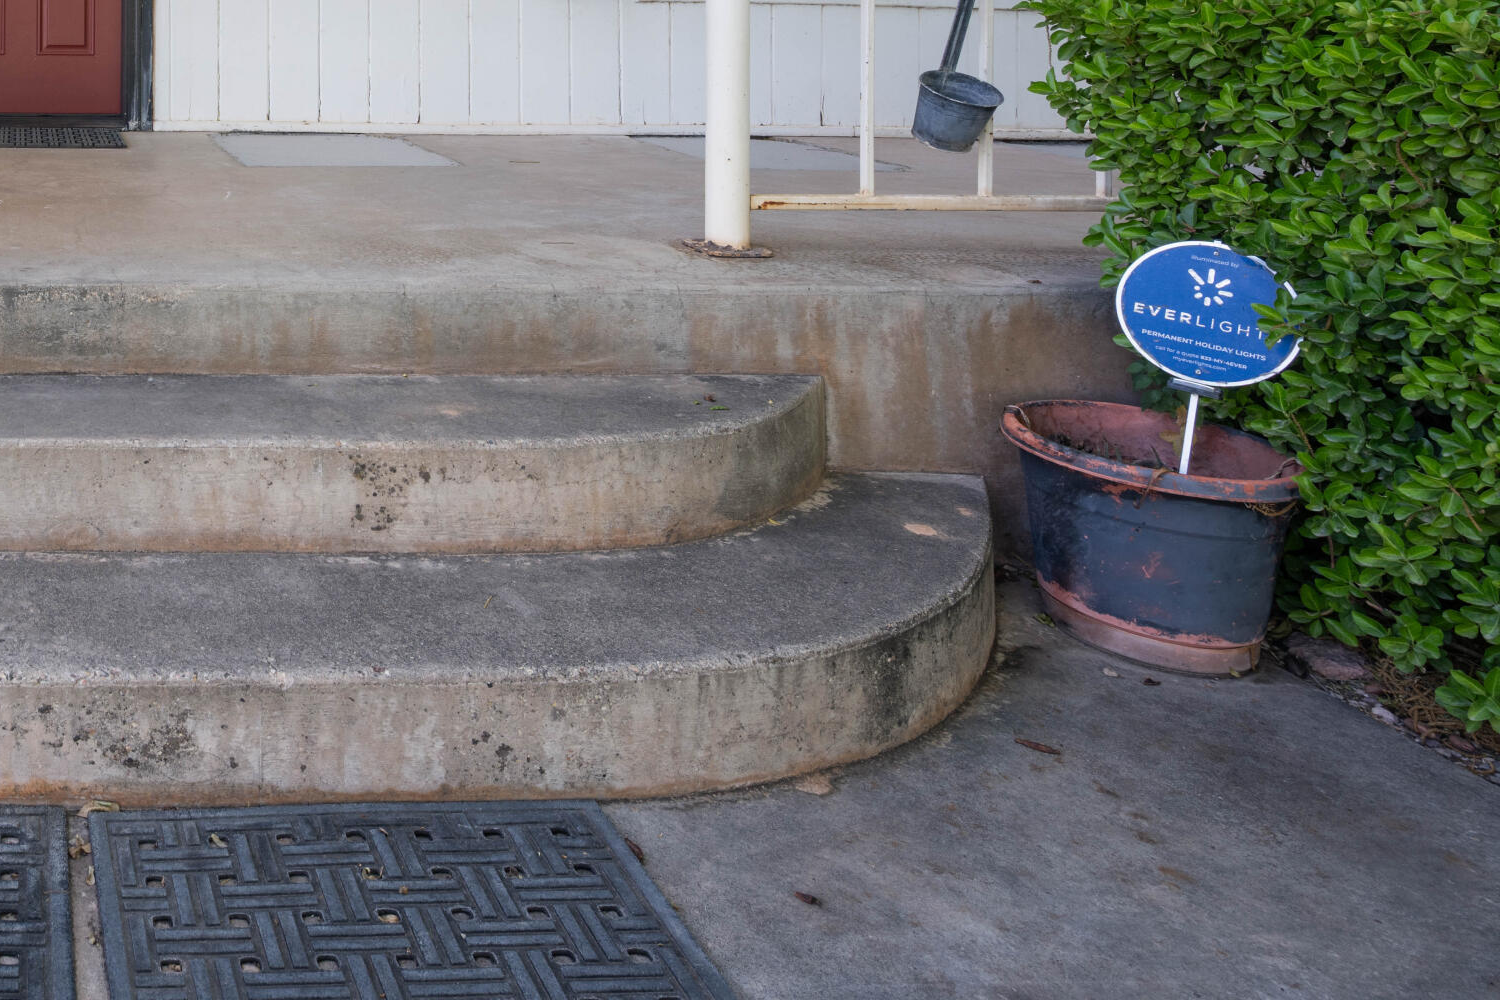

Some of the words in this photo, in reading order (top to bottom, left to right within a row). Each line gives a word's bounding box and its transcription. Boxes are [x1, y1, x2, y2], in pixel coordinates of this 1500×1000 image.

[1133, 301, 1282, 344] EVERLIGHT
[1141, 328, 1194, 345] PERMANENT
[1195, 340, 1234, 354] HOLIDAY
[1235, 349, 1267, 361] LIGHTS
